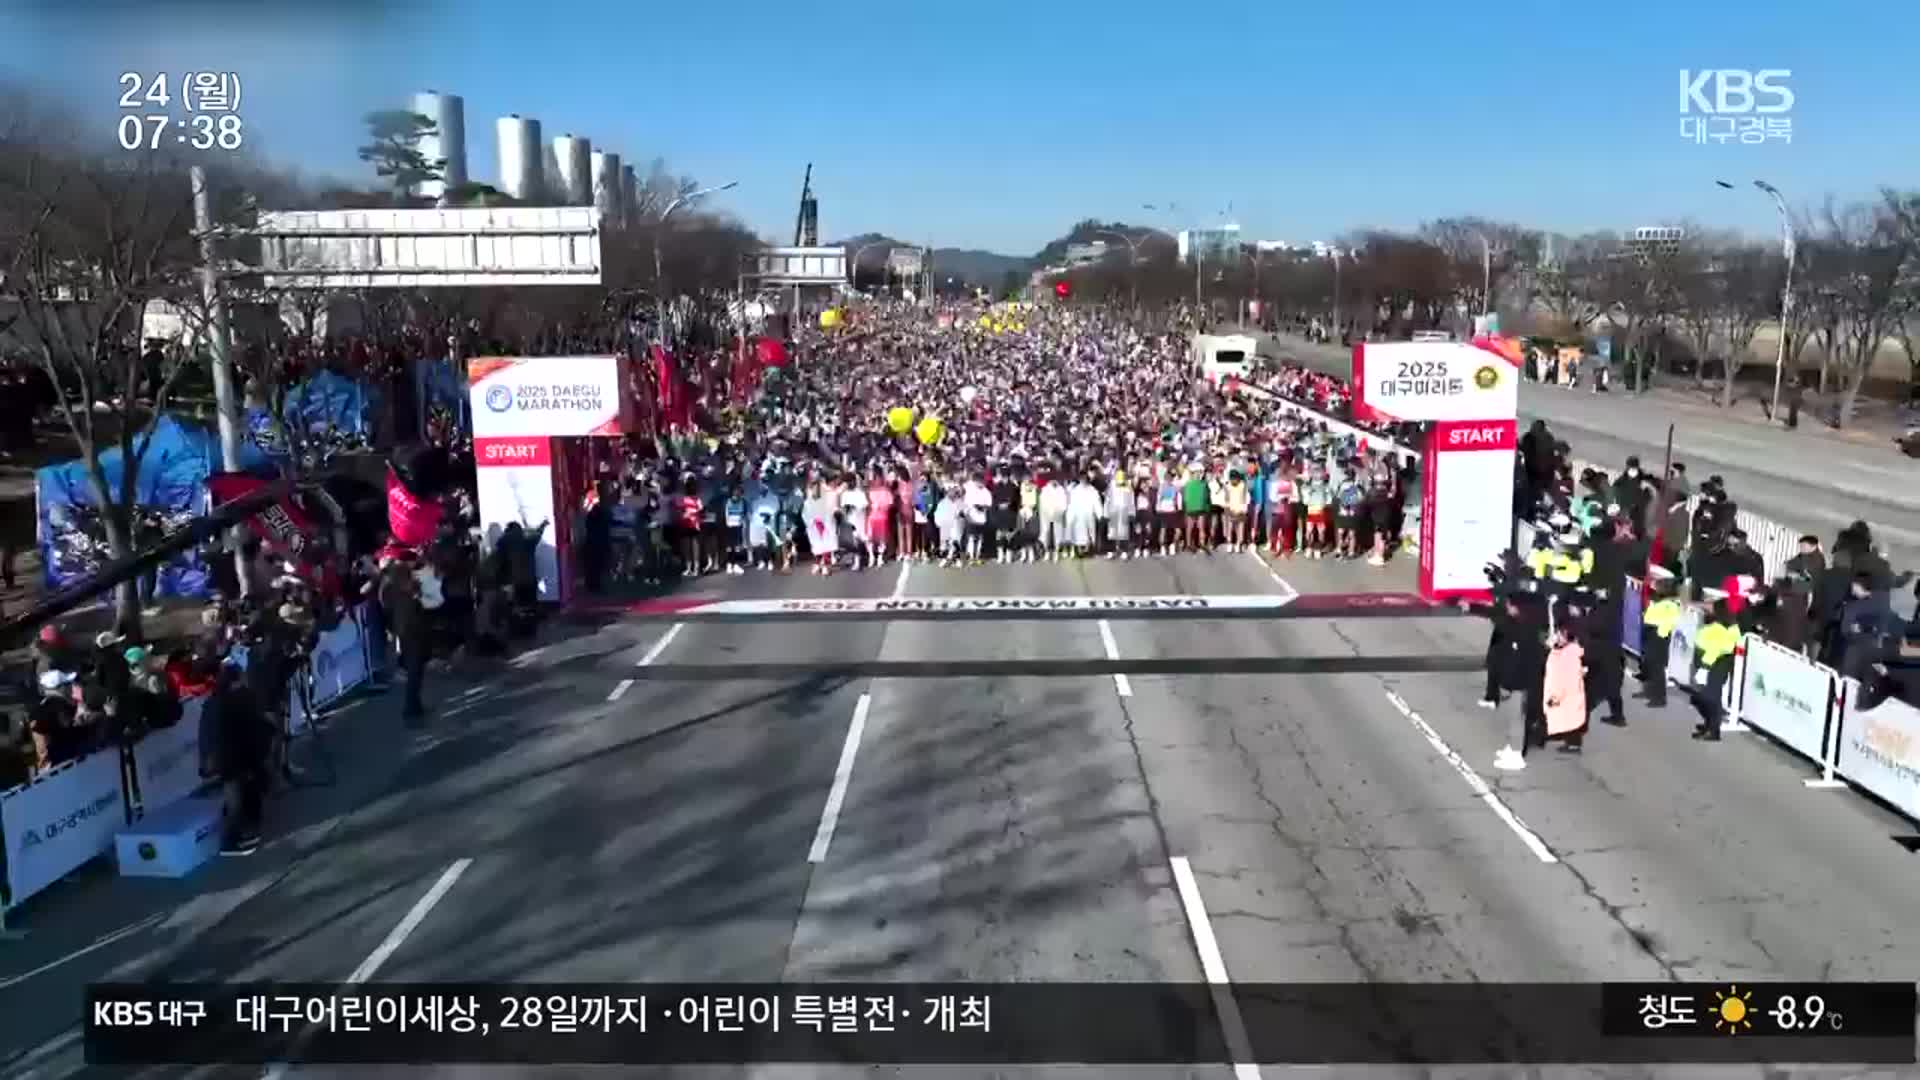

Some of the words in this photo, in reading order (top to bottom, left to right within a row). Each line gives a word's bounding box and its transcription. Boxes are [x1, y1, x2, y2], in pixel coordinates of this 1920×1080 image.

[1397, 361, 1448, 378] 2025
[516, 384, 547, 398] 2025
[551, 384, 601, 398] DAEGU
[516, 398, 602, 411] MARATHON
[1449, 427, 1504, 445] START
[485, 443, 538, 459] START
